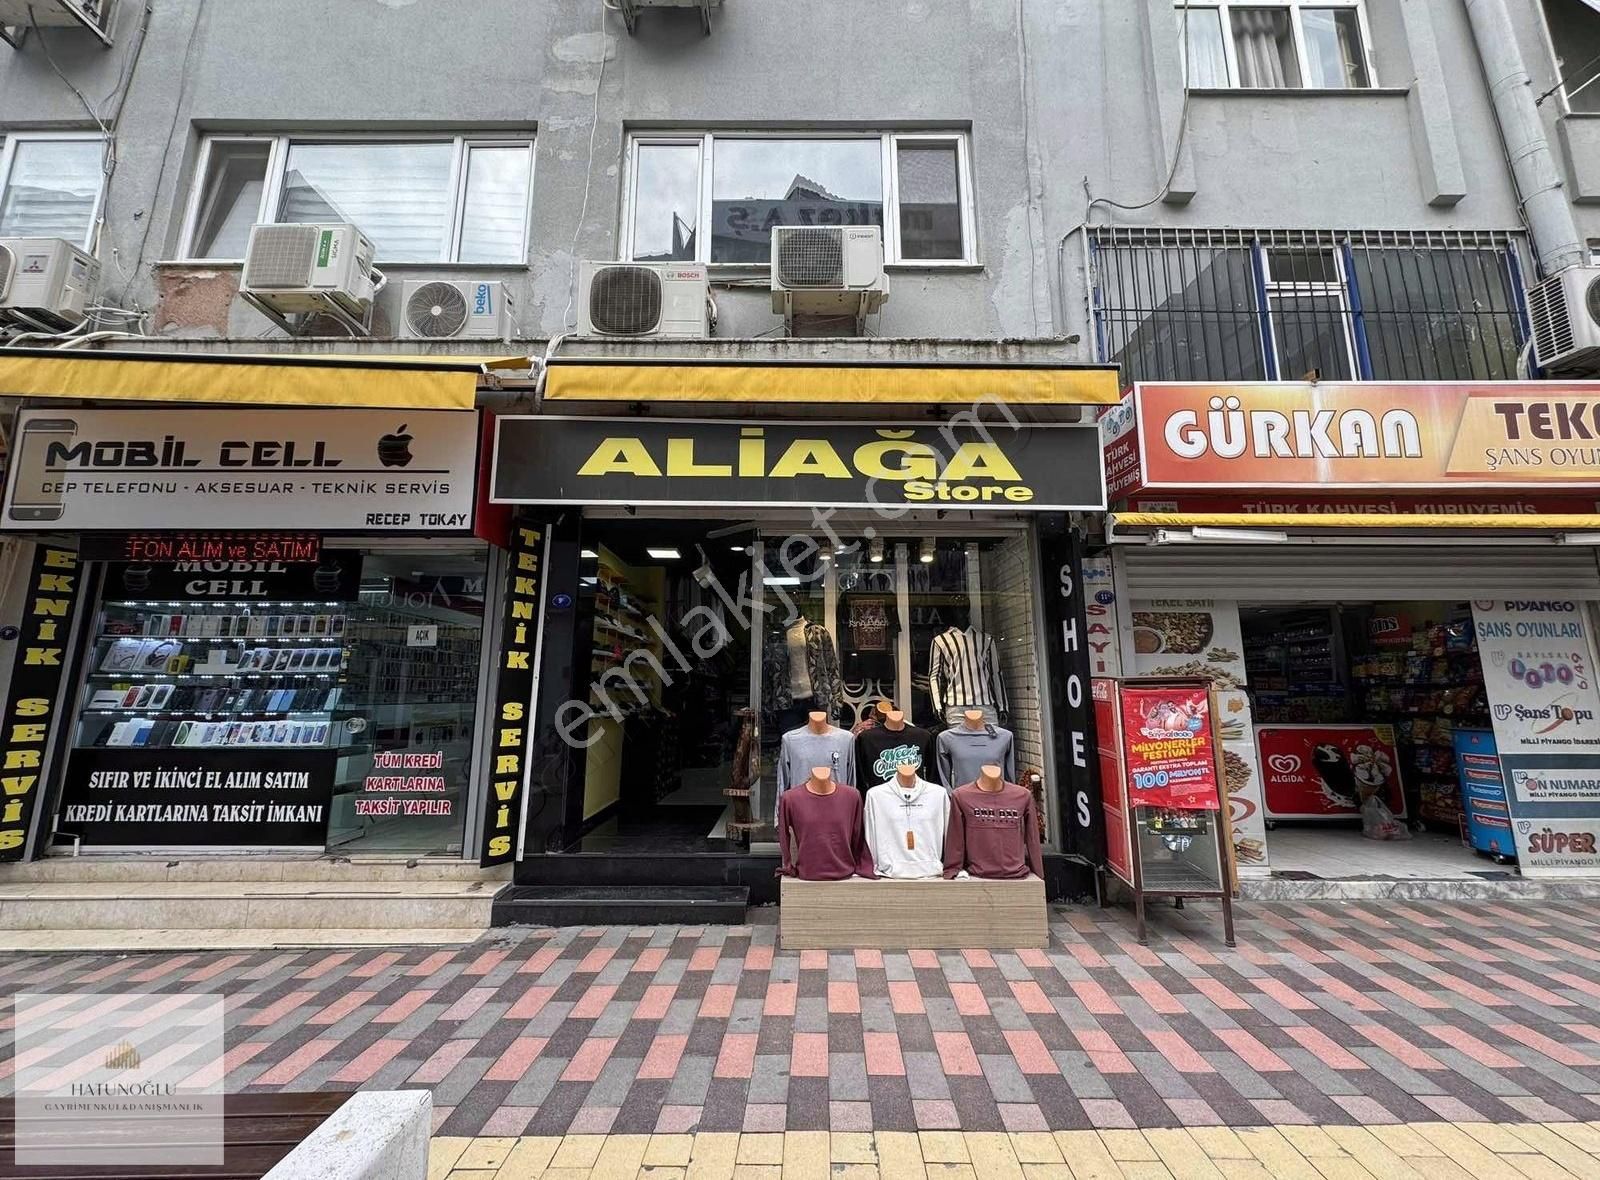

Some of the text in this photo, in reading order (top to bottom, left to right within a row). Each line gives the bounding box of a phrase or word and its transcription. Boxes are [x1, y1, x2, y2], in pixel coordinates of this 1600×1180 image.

[473, 284, 487, 314] beko
[1163, 395, 1422, 459] GÜRKAN
[46, 435, 343, 468] MOBİL CELL
[576, 427, 1024, 481] ALİAĞA
[1105, 442, 1130, 463] TÜRK
[1485, 447, 1600, 471] ŞANS OYU
[1106, 449, 1137, 477] AHVESİ
[42, 481, 77, 495] CEP
[82, 481, 177, 495] TELEFONU
[195, 481, 294, 495] AKSESUAR
[311, 478, 377, 495] TEKNİK
[384, 478, 451, 495] SERVİS
[903, 481, 1034, 502] Store
[1107, 468, 1141, 494] RUYEMİŞ
[366, 513, 467, 526] RECEP TOKAY
[177, 541, 223, 559] ALIM
[228, 545, 247, 558] ve
[253, 541, 313, 559] SATIM
[185, 580, 268, 596] CELL
[416, 629, 430, 643] AÇIK
[1478, 622, 1583, 641] ŞANS OYUNLARI
[1510, 659, 1573, 688] LOTO
[488, 527, 541, 858] TEKNİK SERVİS
[1060, 563, 1091, 828] SHOES
[1514, 703, 1550, 722] Şans
[1132, 737, 1206, 753] MİLYONERLER
[1520, 737, 1539, 745] MİLLİ
[1541, 737, 1572, 745] PİYANGO
[374, 750, 443, 769] TÜM KREDİ
[0, 697, 50, 850] SERVİS
[89, 766, 308, 789] SIFIR VE İKİNCİ EL ALIM SATIM
[365, 776, 445, 792] KARTLARINA
[1133, 770, 1169, 789] 100
[64, 799, 323, 822] KREDİ KARTLARINA TAKSİT İMKANI
[355, 799, 451, 815] TAKSİT YAPILIR
[1528, 827, 1597, 854] SÜPER
